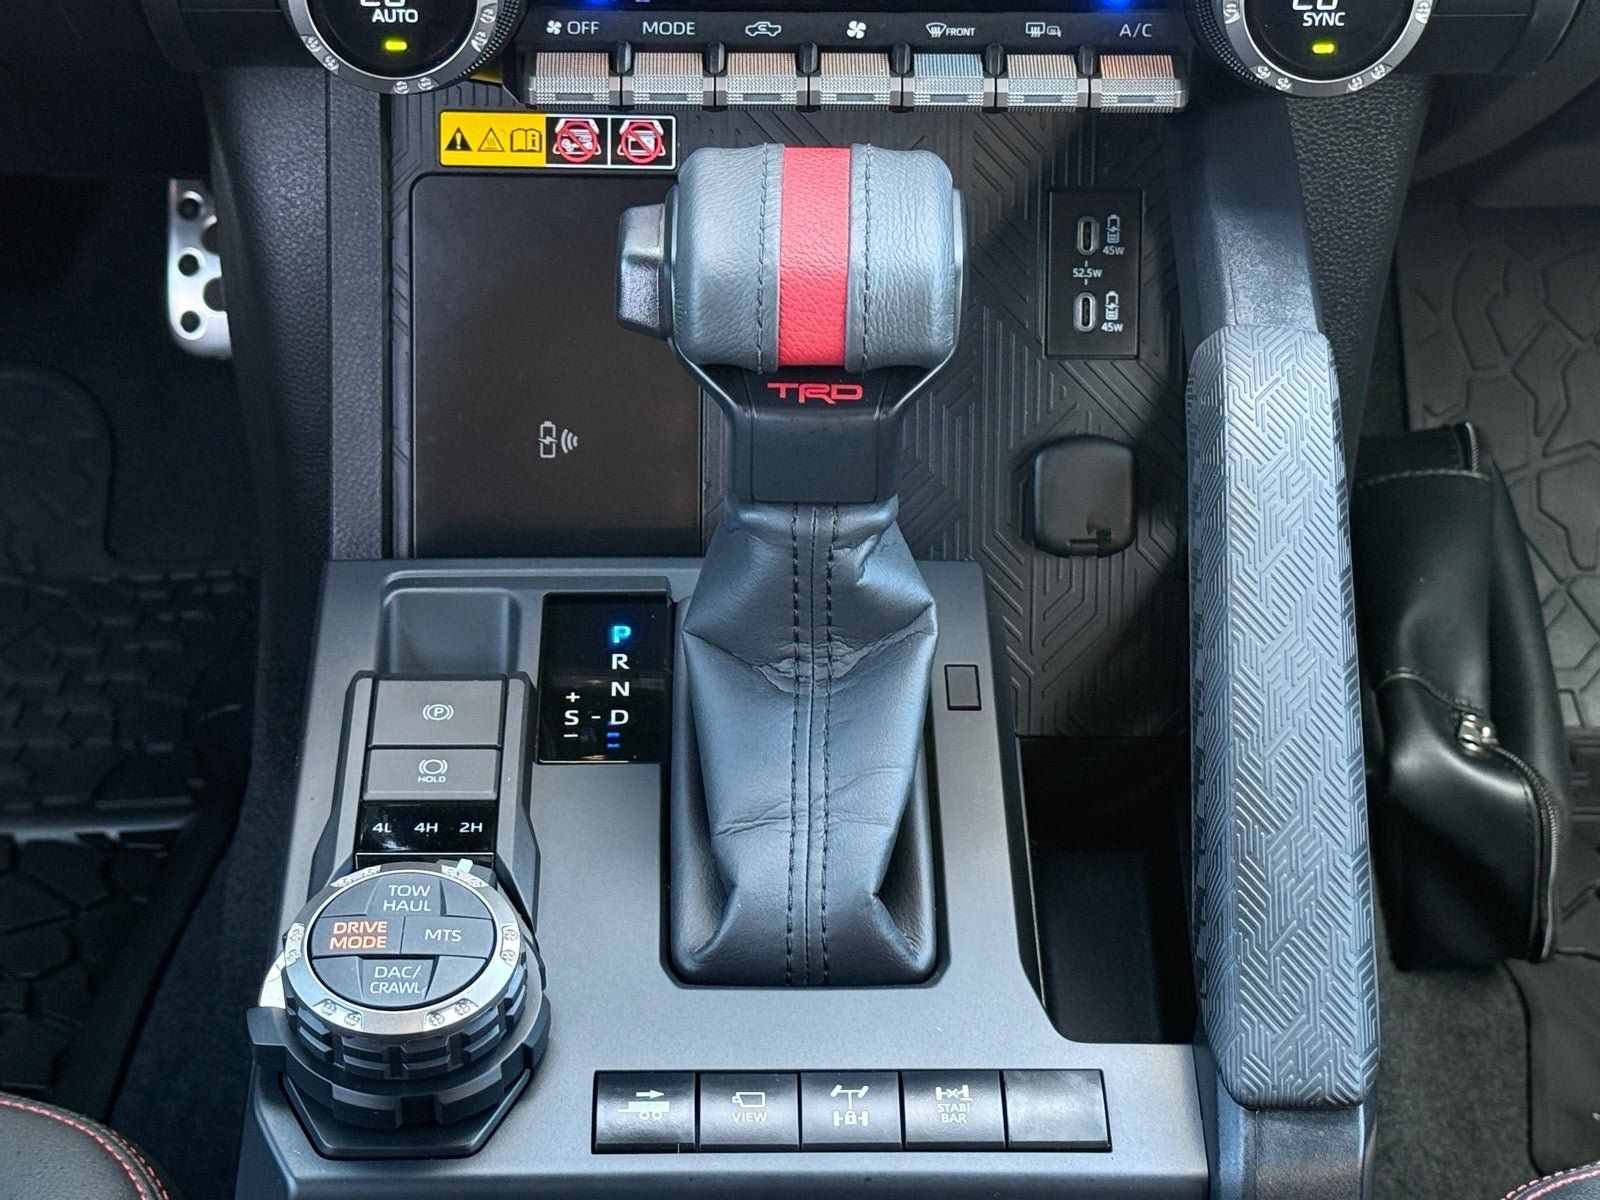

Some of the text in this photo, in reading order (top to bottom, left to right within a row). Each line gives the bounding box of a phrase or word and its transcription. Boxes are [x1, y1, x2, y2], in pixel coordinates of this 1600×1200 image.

[372, 8, 419, 24] AUTO
[1302, 11, 1346, 27] SYNC
[566, 20, 600, 35] OFF
[642, 21, 696, 36] MODE
[945, 27, 976, 37] FRONT
[1119, 23, 1152, 38] A/C
[1101, 245, 1125, 256] 45W
[1072, 267, 1103, 279] 52.5W
[1100, 322, 1124, 333] 45W
[766, 382, 864, 405] TRD
[612, 625, 632, 644] P
[611, 653, 631, 670] R
[611, 681, 630, 697] N
[564, 709, 580, 726] S
[610, 709, 630, 726] D
[371, 822, 393, 834] 4L
[413, 822, 439, 834] 4H
[458, 821, 484, 834] 2H
[388, 885, 431, 897] TOW
[383, 899, 432, 912] HAUL
[333, 921, 388, 935] DRIVE
[424, 928, 462, 942] MTS
[329, 936, 387, 949] MODE
[374, 965, 421, 978] DAC/
[369, 981, 422, 994] CRAWL
[936, 1103, 970, 1113] STABI
[731, 1111, 768, 1123] VIEW
[941, 1113, 967, 1124] BAR
